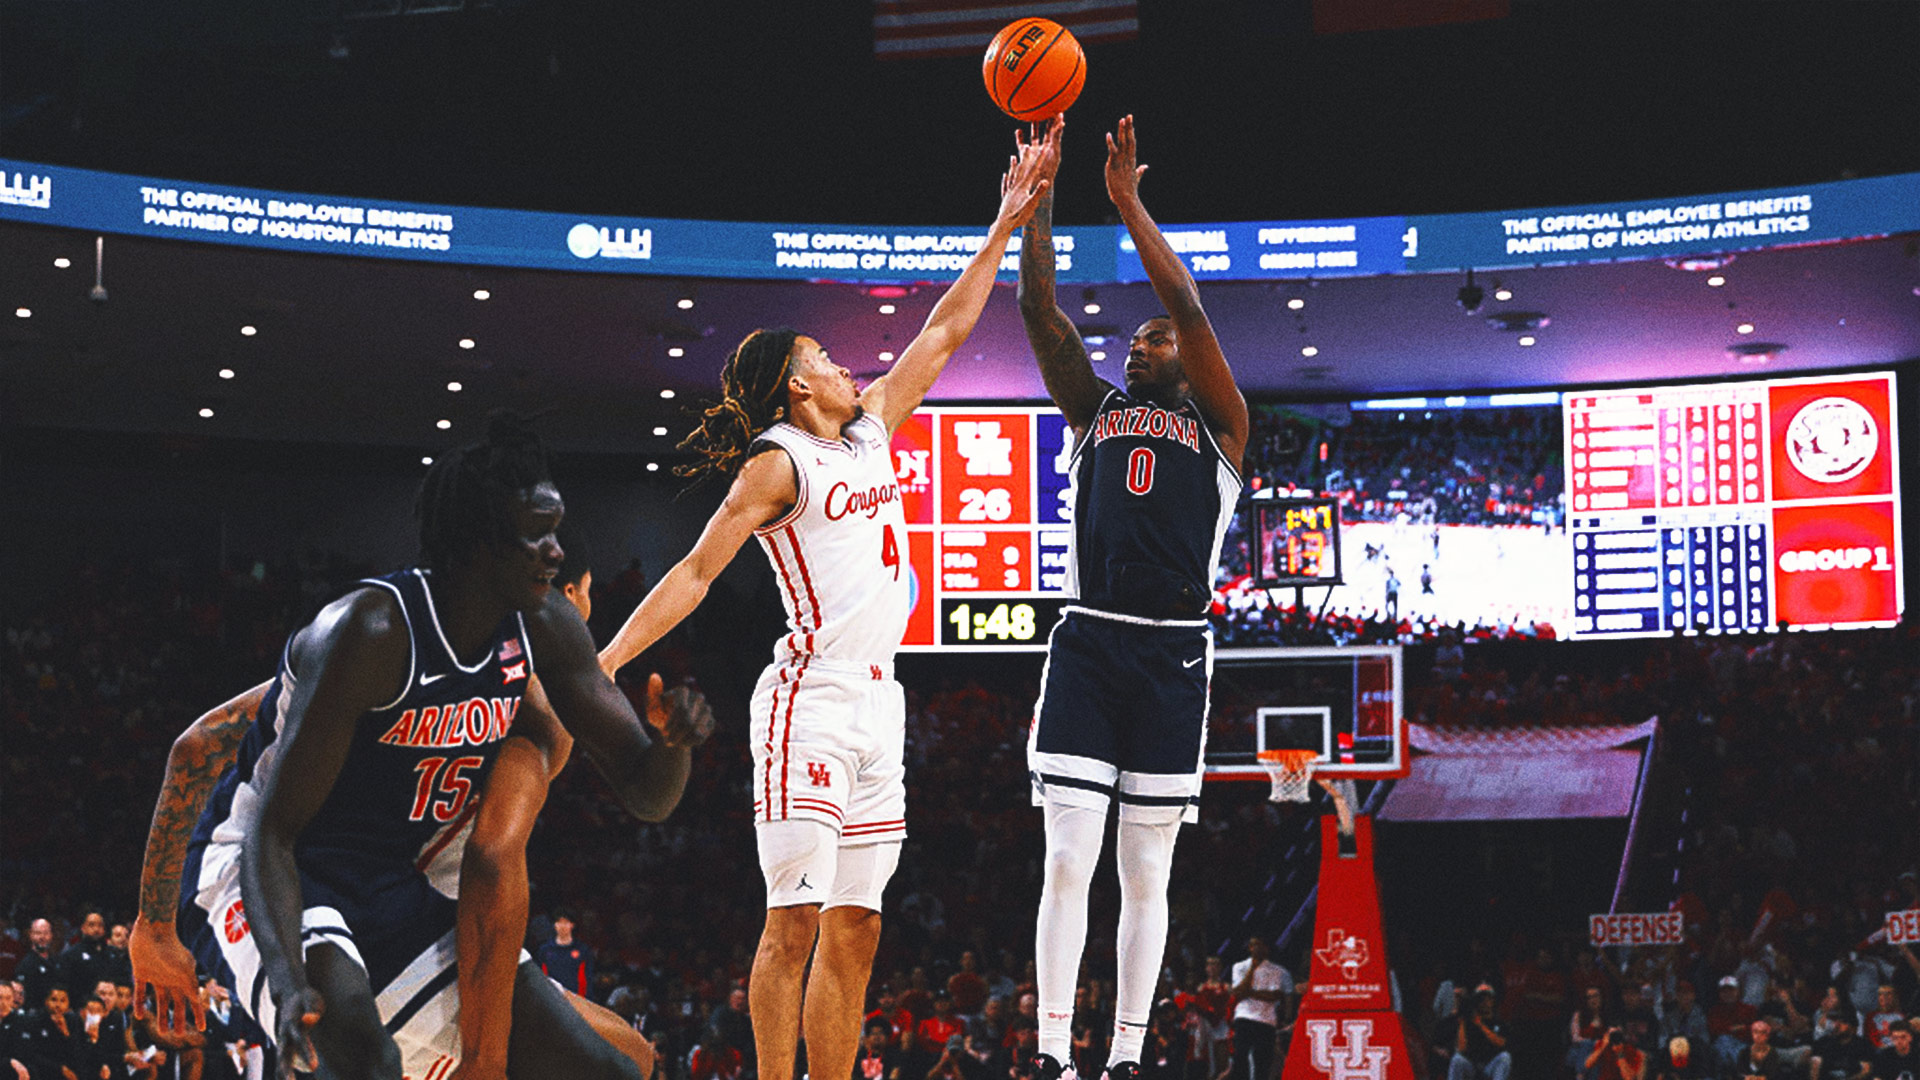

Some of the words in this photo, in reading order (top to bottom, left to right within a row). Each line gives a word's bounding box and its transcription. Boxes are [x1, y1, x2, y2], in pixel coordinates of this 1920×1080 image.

[140, 187, 179, 206] THE
[181, 192, 264, 216] OFFICIAL
[267, 200, 364, 224] EMPLOYEE
[367, 209, 453, 231] BENEFITS
[1502, 218, 1539, 236] THE
[1542, 213, 1623, 234] OFFICIAL
[1626, 204, 1722, 228] EMPLOYEE
[1725, 195, 1812, 219] BENEFITS
[144, 208, 229, 232] PARTNER
[232, 217, 258, 234] OF
[262, 220, 351, 243] HOUSTON
[354, 228, 450, 250] ATHLETICS
[600, 227, 651, 251] LLH
[773, 233, 809, 249] THE
[811, 234, 892, 251] OFFICIAL
[1507, 235, 1589, 254] PARTNER
[1592, 231, 1619, 248] OF
[1621, 224, 1709, 246] HOUSTON
[1713, 215, 1810, 238] ATHLETICS
[776, 252, 858, 268] PARTNER
[860, 254, 889, 270] OF
[1094, 406, 1201, 454] ARIZONA
[1126, 447, 1155, 496] 0
[824, 481, 899, 521] Cougar
[959, 488, 1011, 521] 26
[1286, 505, 1332, 530] 1:47
[881, 524, 900, 582] 4
[950, 603, 1035, 640] 1:48
[378, 696, 522, 748] ARIZON
[409, 756, 484, 822] 15
[807, 762, 831, 787] UH
[1592, 914, 1681, 943] DEFENSE
[1889, 912, 1920, 941] DE
[1306, 1019, 1391, 1080] UH
